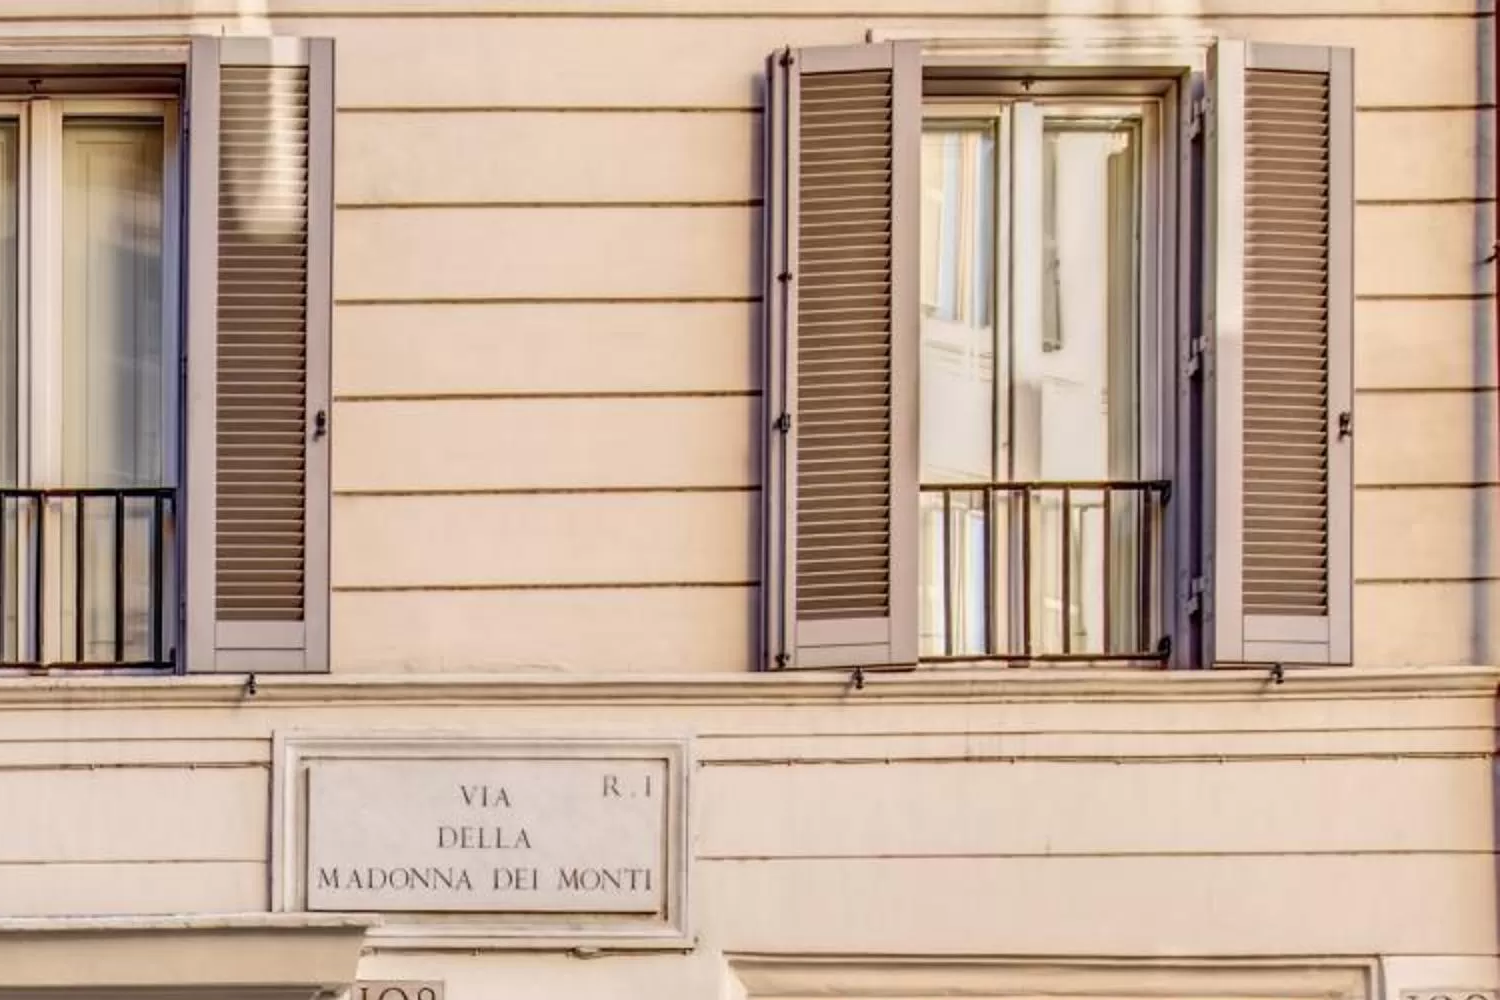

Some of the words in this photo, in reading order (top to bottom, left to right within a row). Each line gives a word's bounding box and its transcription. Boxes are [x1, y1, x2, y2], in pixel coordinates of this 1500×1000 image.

[459, 784, 512, 808] VIA
[437, 826, 532, 850] DELLA
[317, 866, 474, 891] MADONNA
[492, 868, 539, 891] DEI
[556, 868, 653, 891] MONTI
